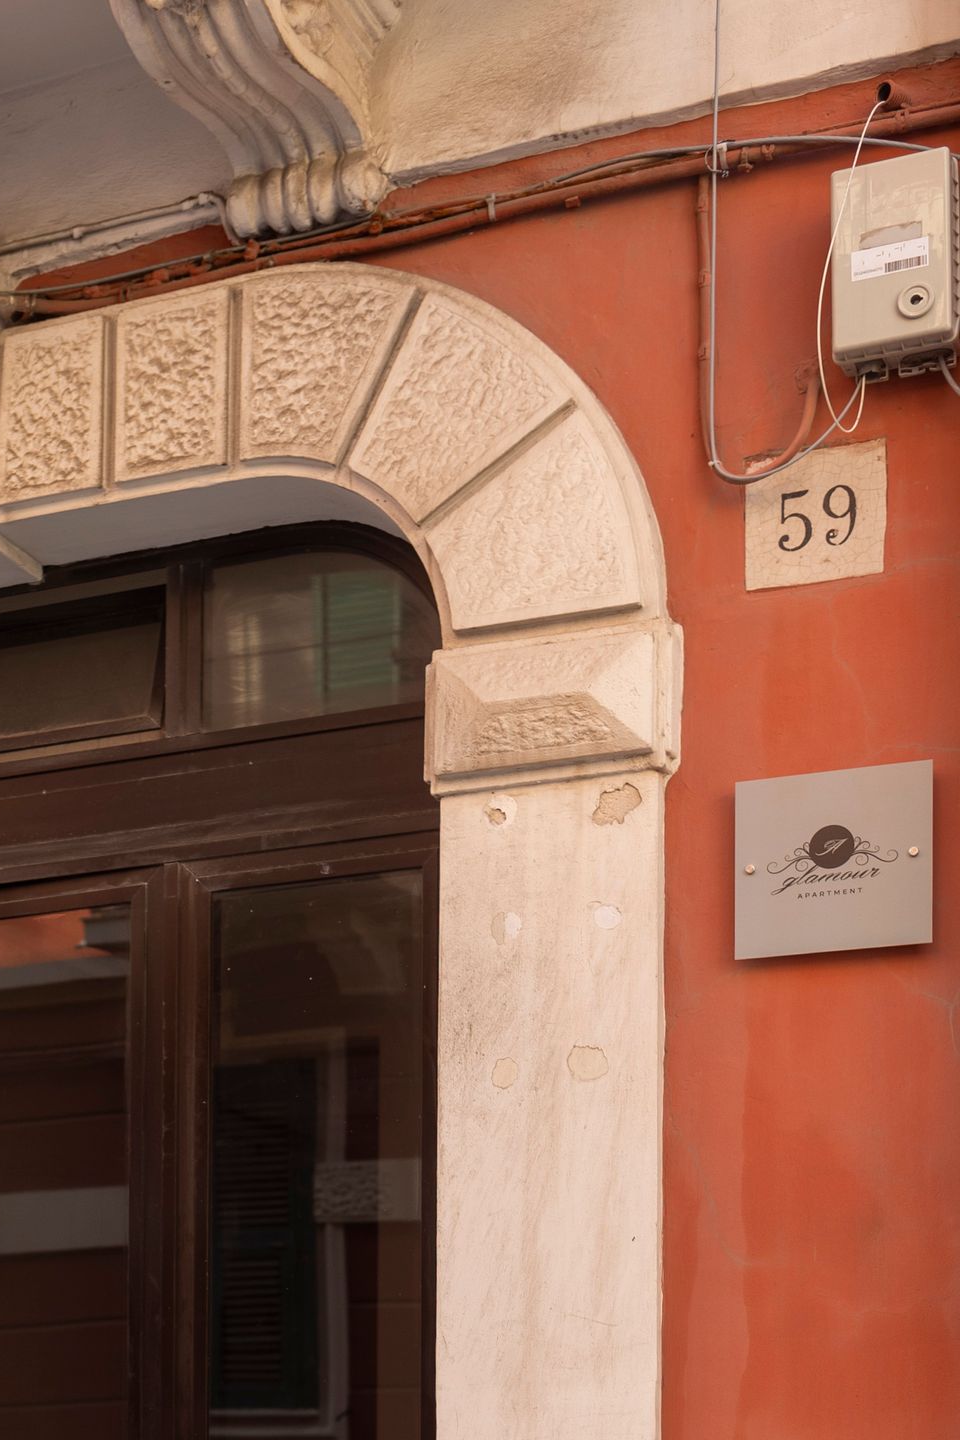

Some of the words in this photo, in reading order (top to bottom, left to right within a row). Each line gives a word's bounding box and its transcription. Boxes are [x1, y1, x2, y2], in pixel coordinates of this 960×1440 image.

[778, 484, 857, 552] 59
[770, 864, 880, 896] glamour
[797, 887, 863, 899] APARTMENT
